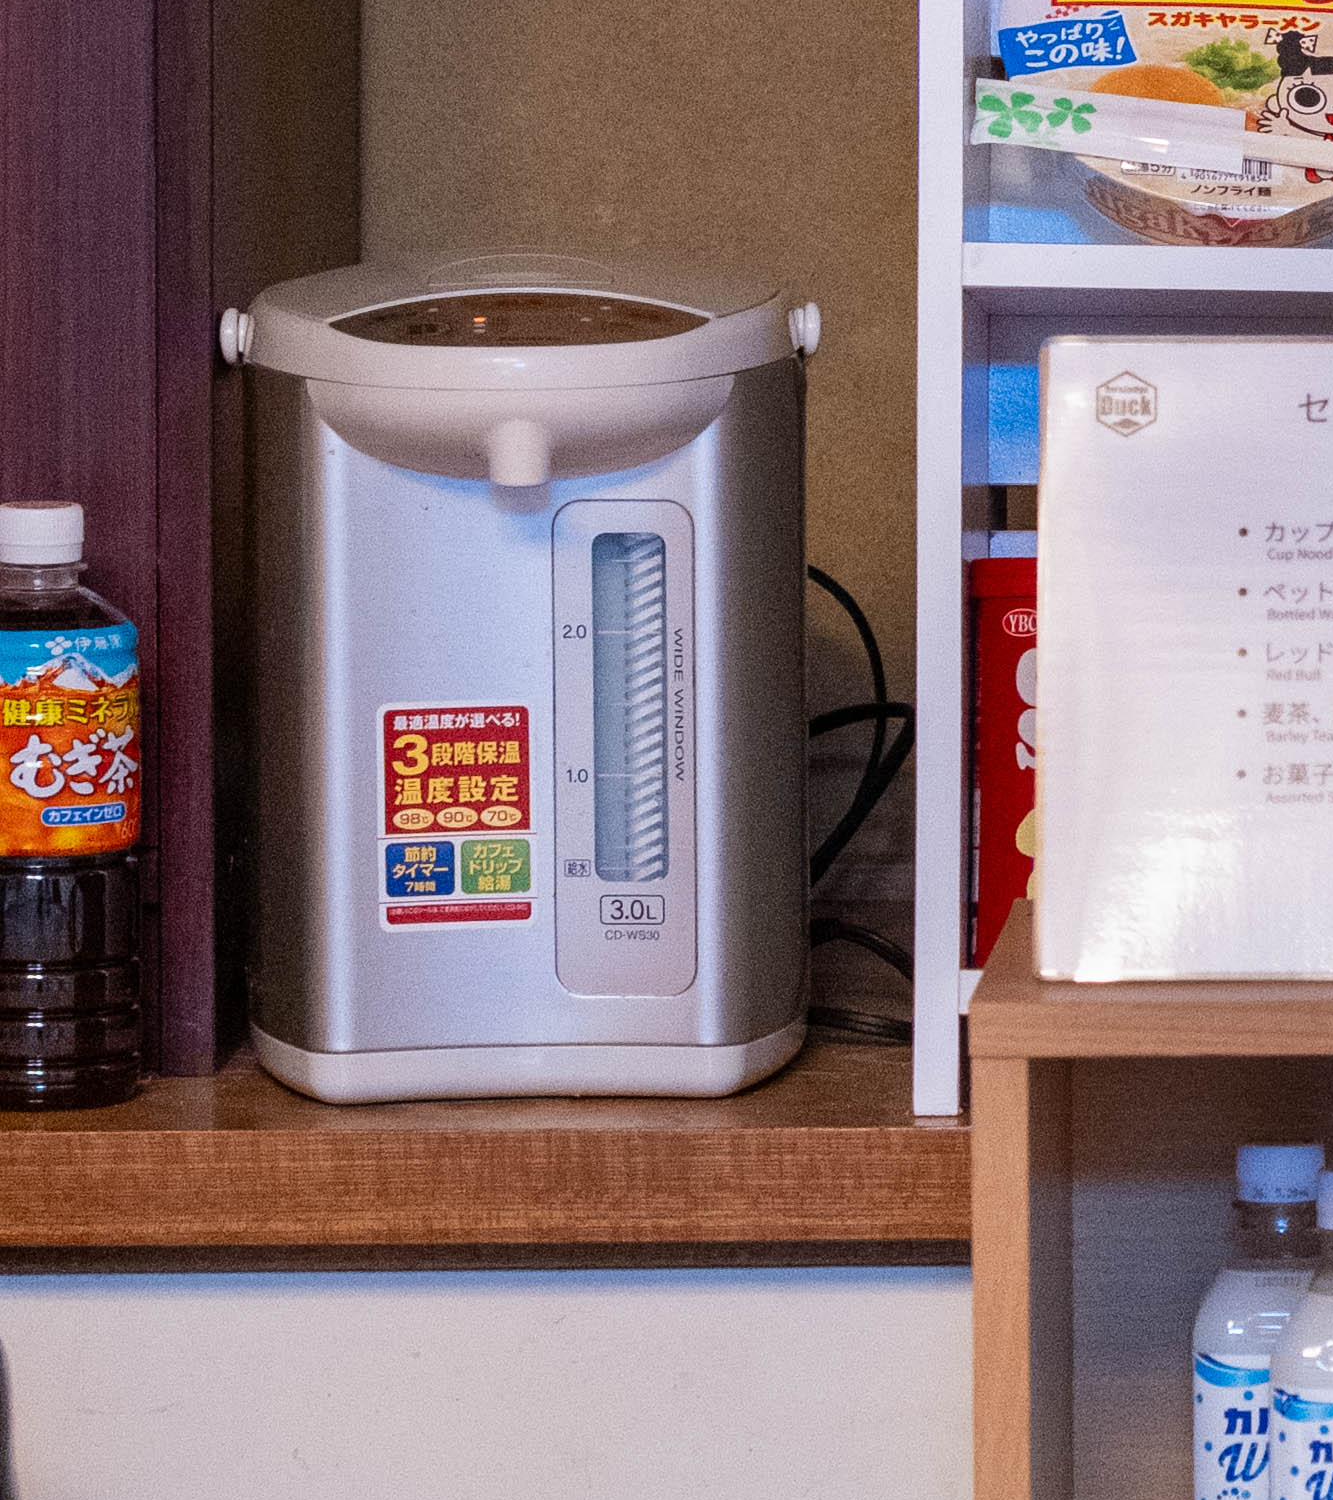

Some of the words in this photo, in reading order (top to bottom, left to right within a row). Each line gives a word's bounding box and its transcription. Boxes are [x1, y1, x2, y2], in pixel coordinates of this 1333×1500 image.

[1147, 12, 1320, 32] スガキヤラーメン
[1016, 22, 1104, 46] やっぱり
[1025, 37, 1127, 65] この味!
[1191, 185, 1272, 196] ノンフライ麺
[562, 625, 587, 640] 2.0
[673, 628, 684, 682] WIDE
[393, 712, 520, 731] 最適温度が選べる!
[674, 689, 685, 781] WINDOW
[9, 725, 138, 798] むぎ茶
[392, 734, 520, 776] 3段階保温
[566, 769, 588, 783] 1.0
[394, 775, 519, 805] 温度設定
[48, 805, 122, 823] カフェインゼロ
[398, 812, 429, 825] 98℃
[442, 811, 473, 825] 90℃
[405, 846, 437, 863] 節約
[472, 844, 514, 859] カフェ
[392, 864, 449, 878] タイマー
[468, 859, 521, 875] ドリップ
[610, 900, 656, 921] 3.0L
[604, 929, 660, 941] CD-WS30
